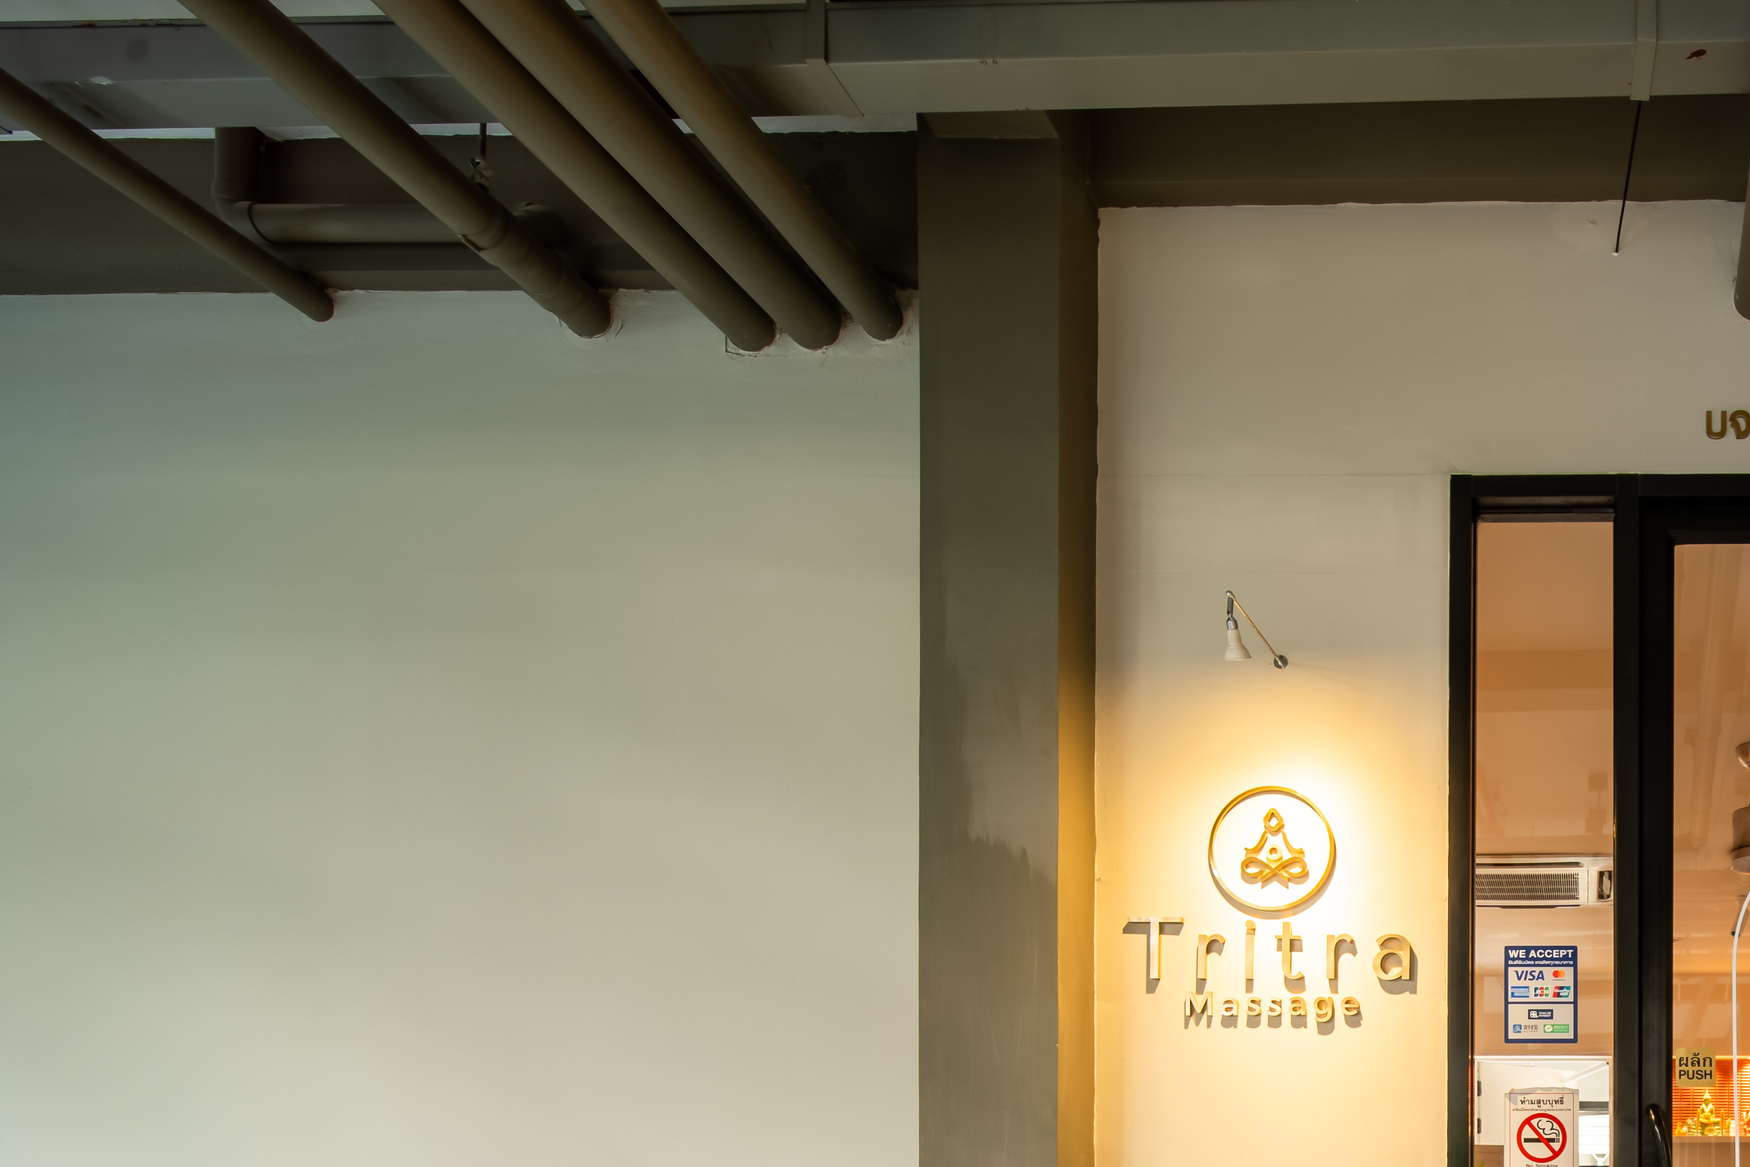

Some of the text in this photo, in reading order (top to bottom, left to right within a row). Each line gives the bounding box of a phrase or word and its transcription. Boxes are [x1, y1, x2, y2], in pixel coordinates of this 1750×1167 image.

[1126, 916, 1412, 981] Tritra
[1508, 949, 1574, 959] WE ACCEPT
[1513, 970, 1545, 981] VISA
[1185, 991, 1361, 1022] Massage
[1678, 1053, 1713, 1068] ผลัก
[1678, 1070, 1713, 1081] PUSH
